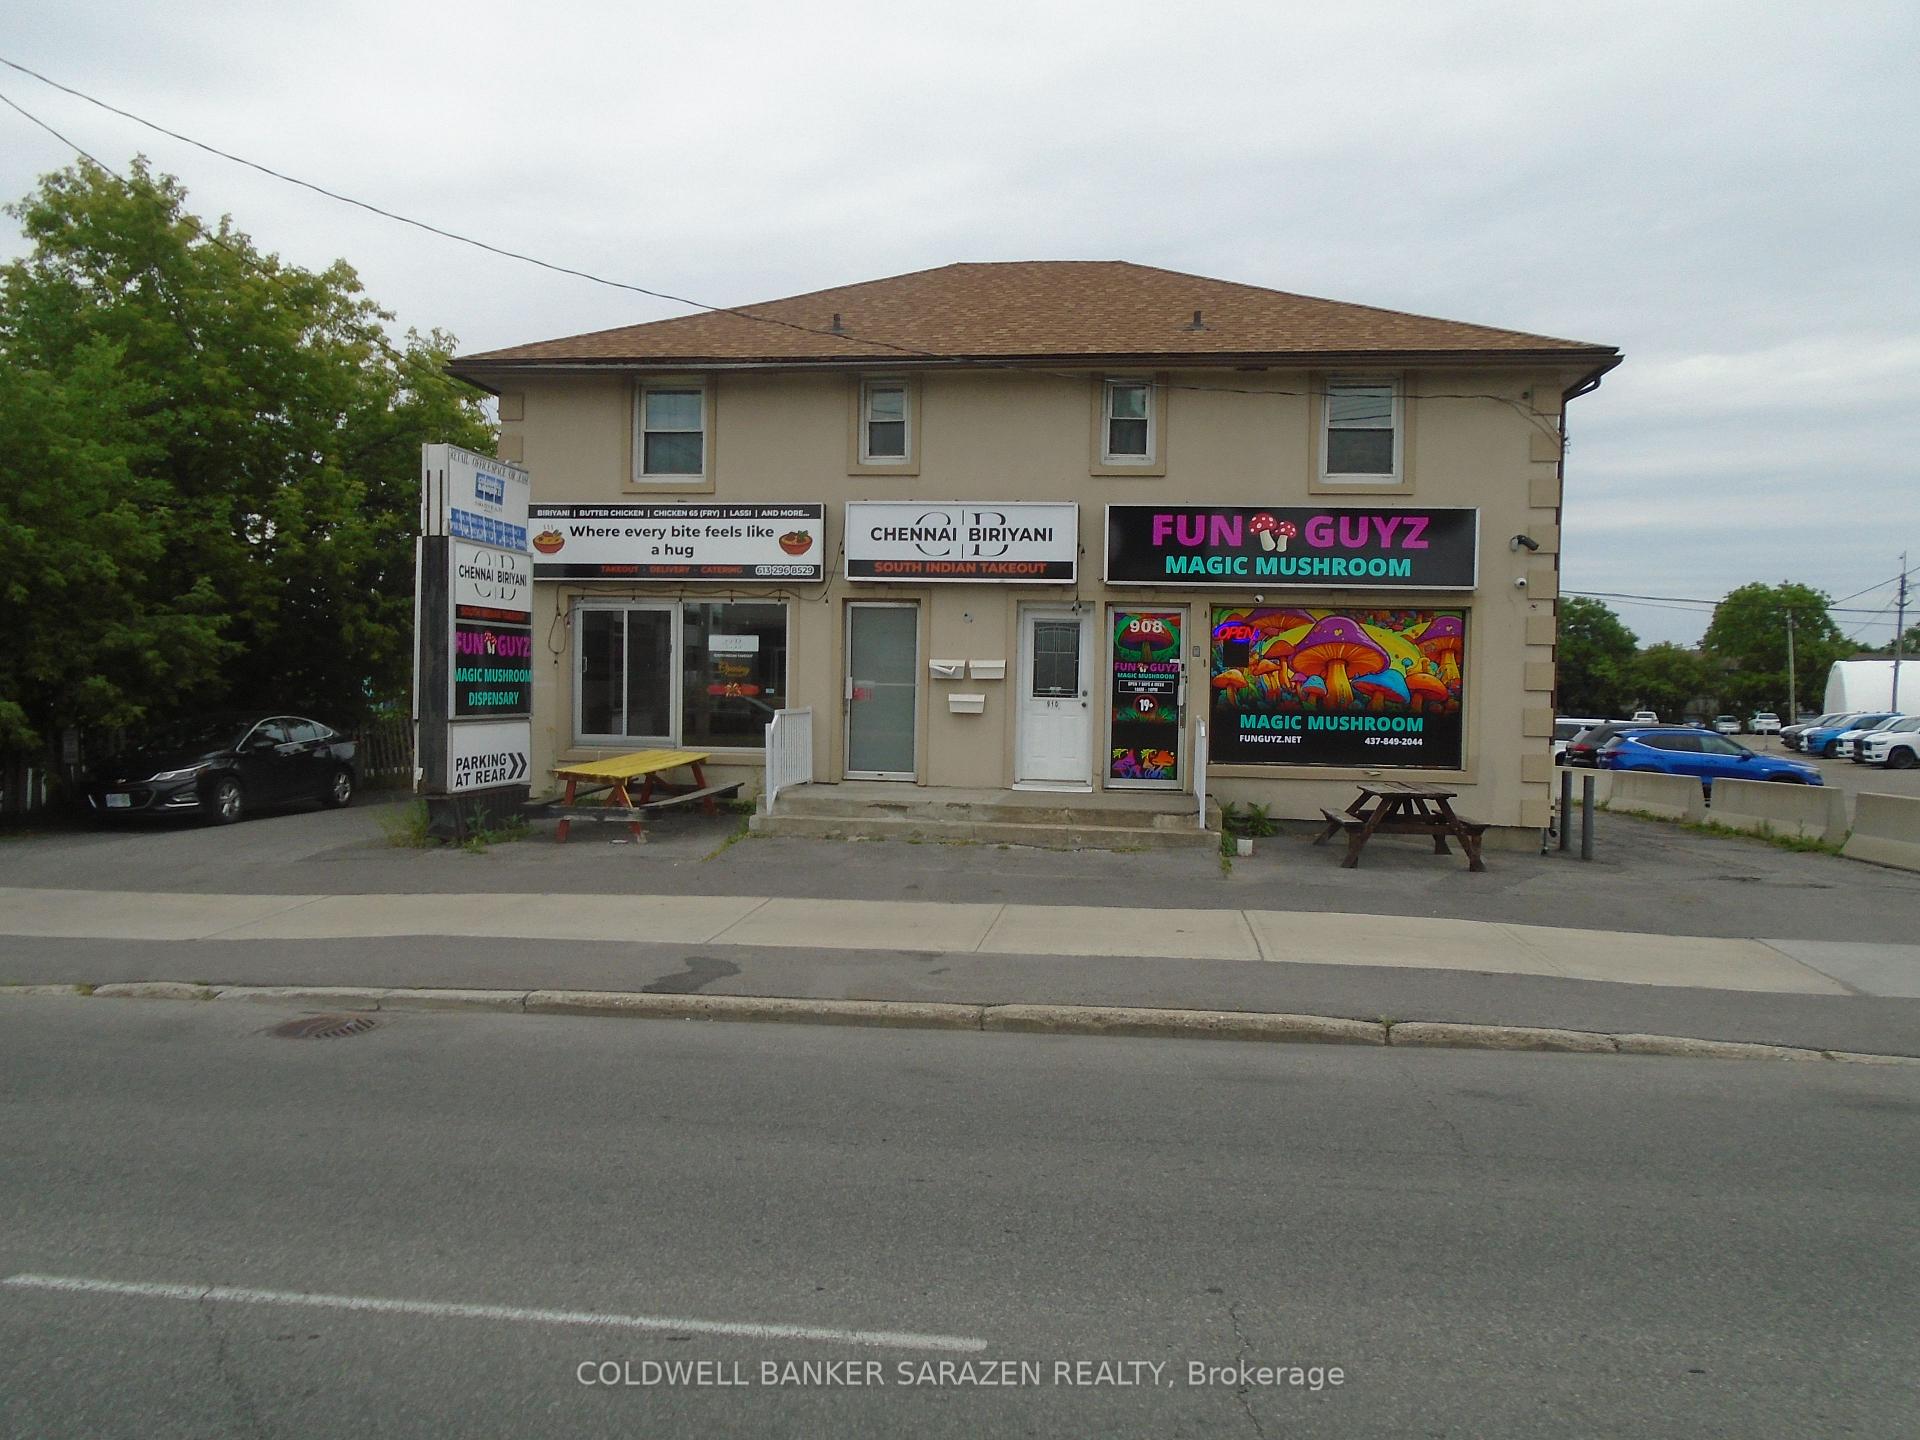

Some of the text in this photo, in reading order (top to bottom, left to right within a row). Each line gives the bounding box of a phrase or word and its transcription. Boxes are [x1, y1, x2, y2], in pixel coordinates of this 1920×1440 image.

[537, 509, 570, 517] BIRIYANI
[580, 509, 609, 517] BUTTER
[610, 509, 644, 517] CHICKEN
[653, 509, 687, 517] CHICKEN
[700, 509, 720, 518] (FRY)
[729, 509, 752, 517] LASSI
[761, 509, 779, 517] AND
[570, 525, 774, 540] Where every bite feels like
[870, 527, 1053, 542] CHENNAI BIRIYANI
[1152, 514, 1430, 549] FUN GUYZ
[651, 543, 694, 558] a hug
[756, 565, 814, 576] 613 296 8529
[874, 562, 1047, 574] SOUTH INDIAN TAKEOUT
[1165, 556, 1411, 577] MAGIC MUSHROOM
[459, 565, 527, 587] CHENNAI BIRIYANI
[1130, 618, 1163, 633] 908
[1218, 625, 1256, 640] OPEN
[455, 631, 531, 657] FUN GUYZ
[1114, 662, 1179, 672] FUN GUYZ
[455, 667, 531, 683] MAGIC MUSHROOM
[468, 691, 519, 706] DISPENSARY
[1240, 714, 1424, 732] MAGIC MUSHROOM
[1239, 734, 1423, 746] FUNGUYZ.NET 437-849-2044
[455, 752, 507, 772] PARKING
[455, 768, 508, 787] AT REAR
